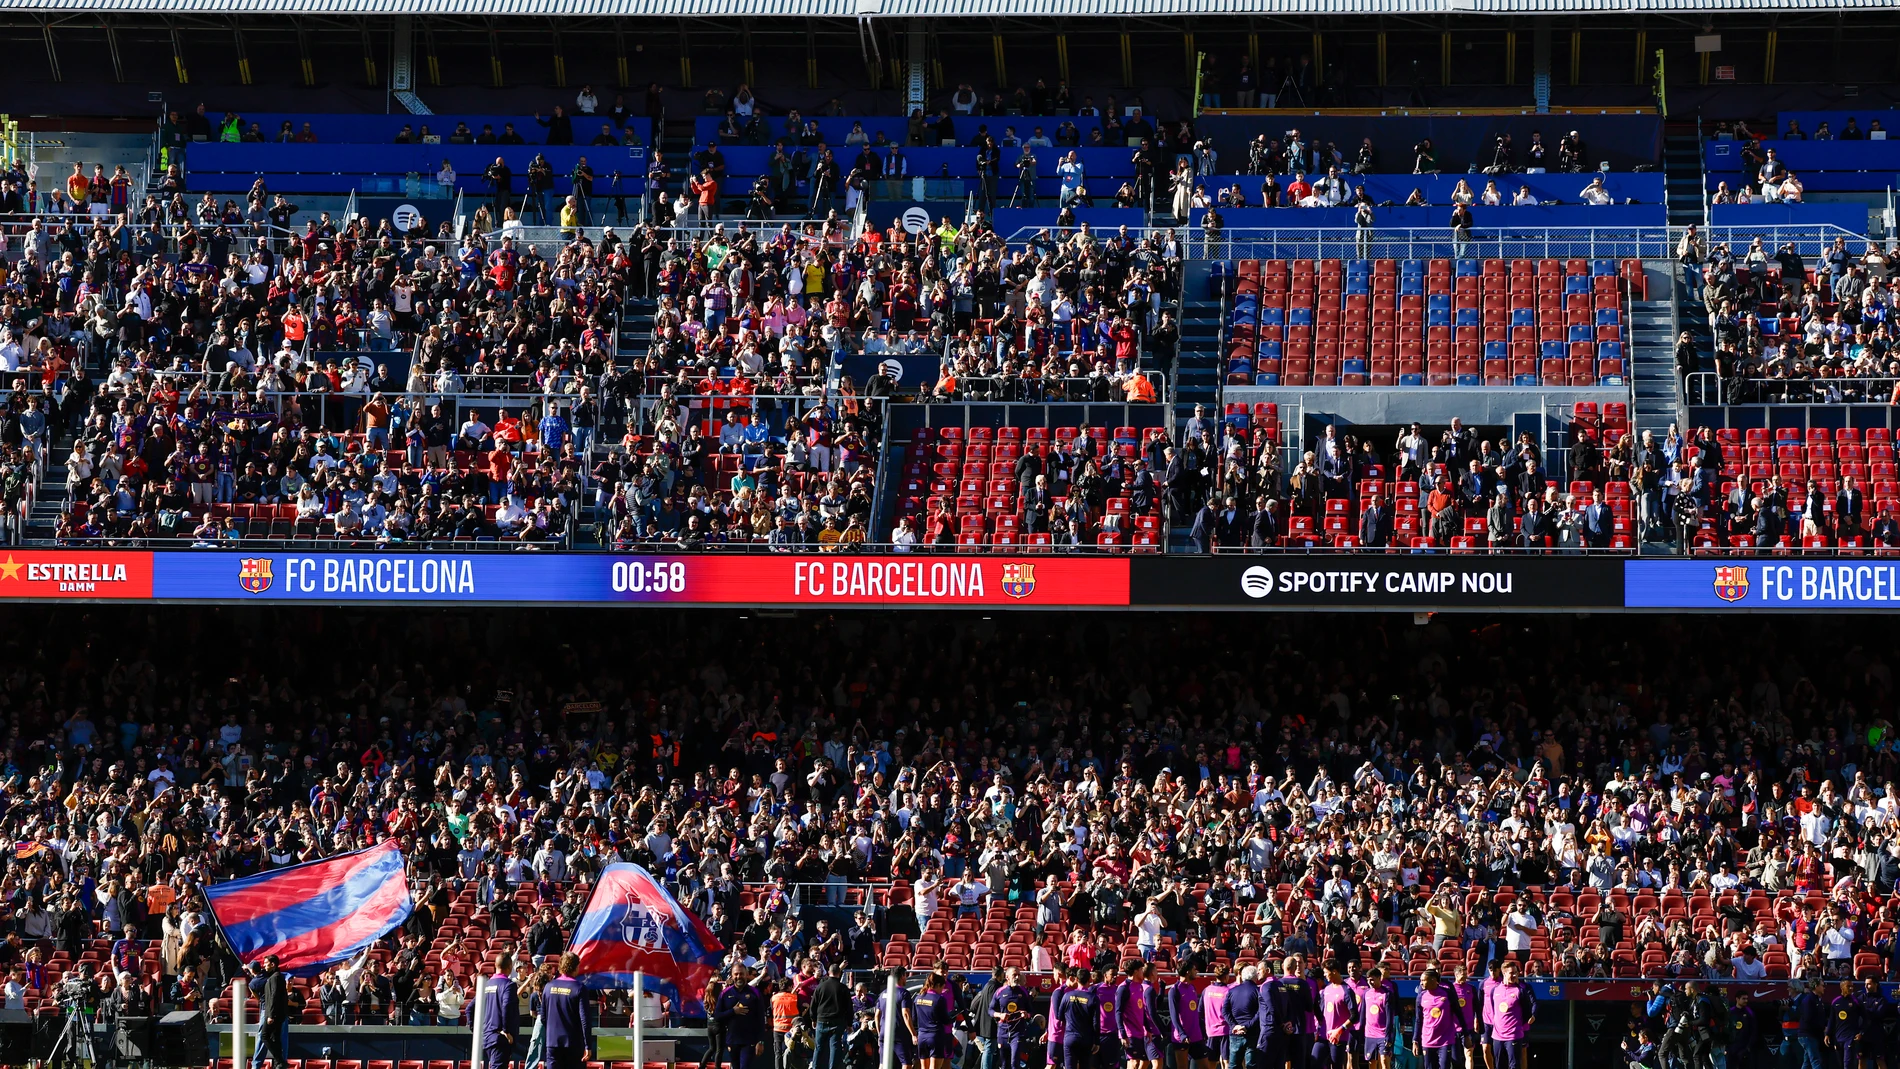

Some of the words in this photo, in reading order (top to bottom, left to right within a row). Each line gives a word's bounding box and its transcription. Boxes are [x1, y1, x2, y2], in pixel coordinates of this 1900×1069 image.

[27, 563, 127, 581] ESTRELLA
[59, 582, 95, 592] DAMM
[285, 558, 316, 593] FC
[323, 558, 475, 594] BARCELONA
[612, 561, 686, 593] 00:58
[794, 561, 825, 596] FC
[832, 561, 984, 597] BARCELONA
[1278, 571, 1380, 593] SPOTIFY
[1385, 571, 1456, 593] CAMP
[1462, 571, 1512, 593] NOU
[1762, 565, 1793, 600] FC
[1801, 565, 1900, 601] BARCEL
